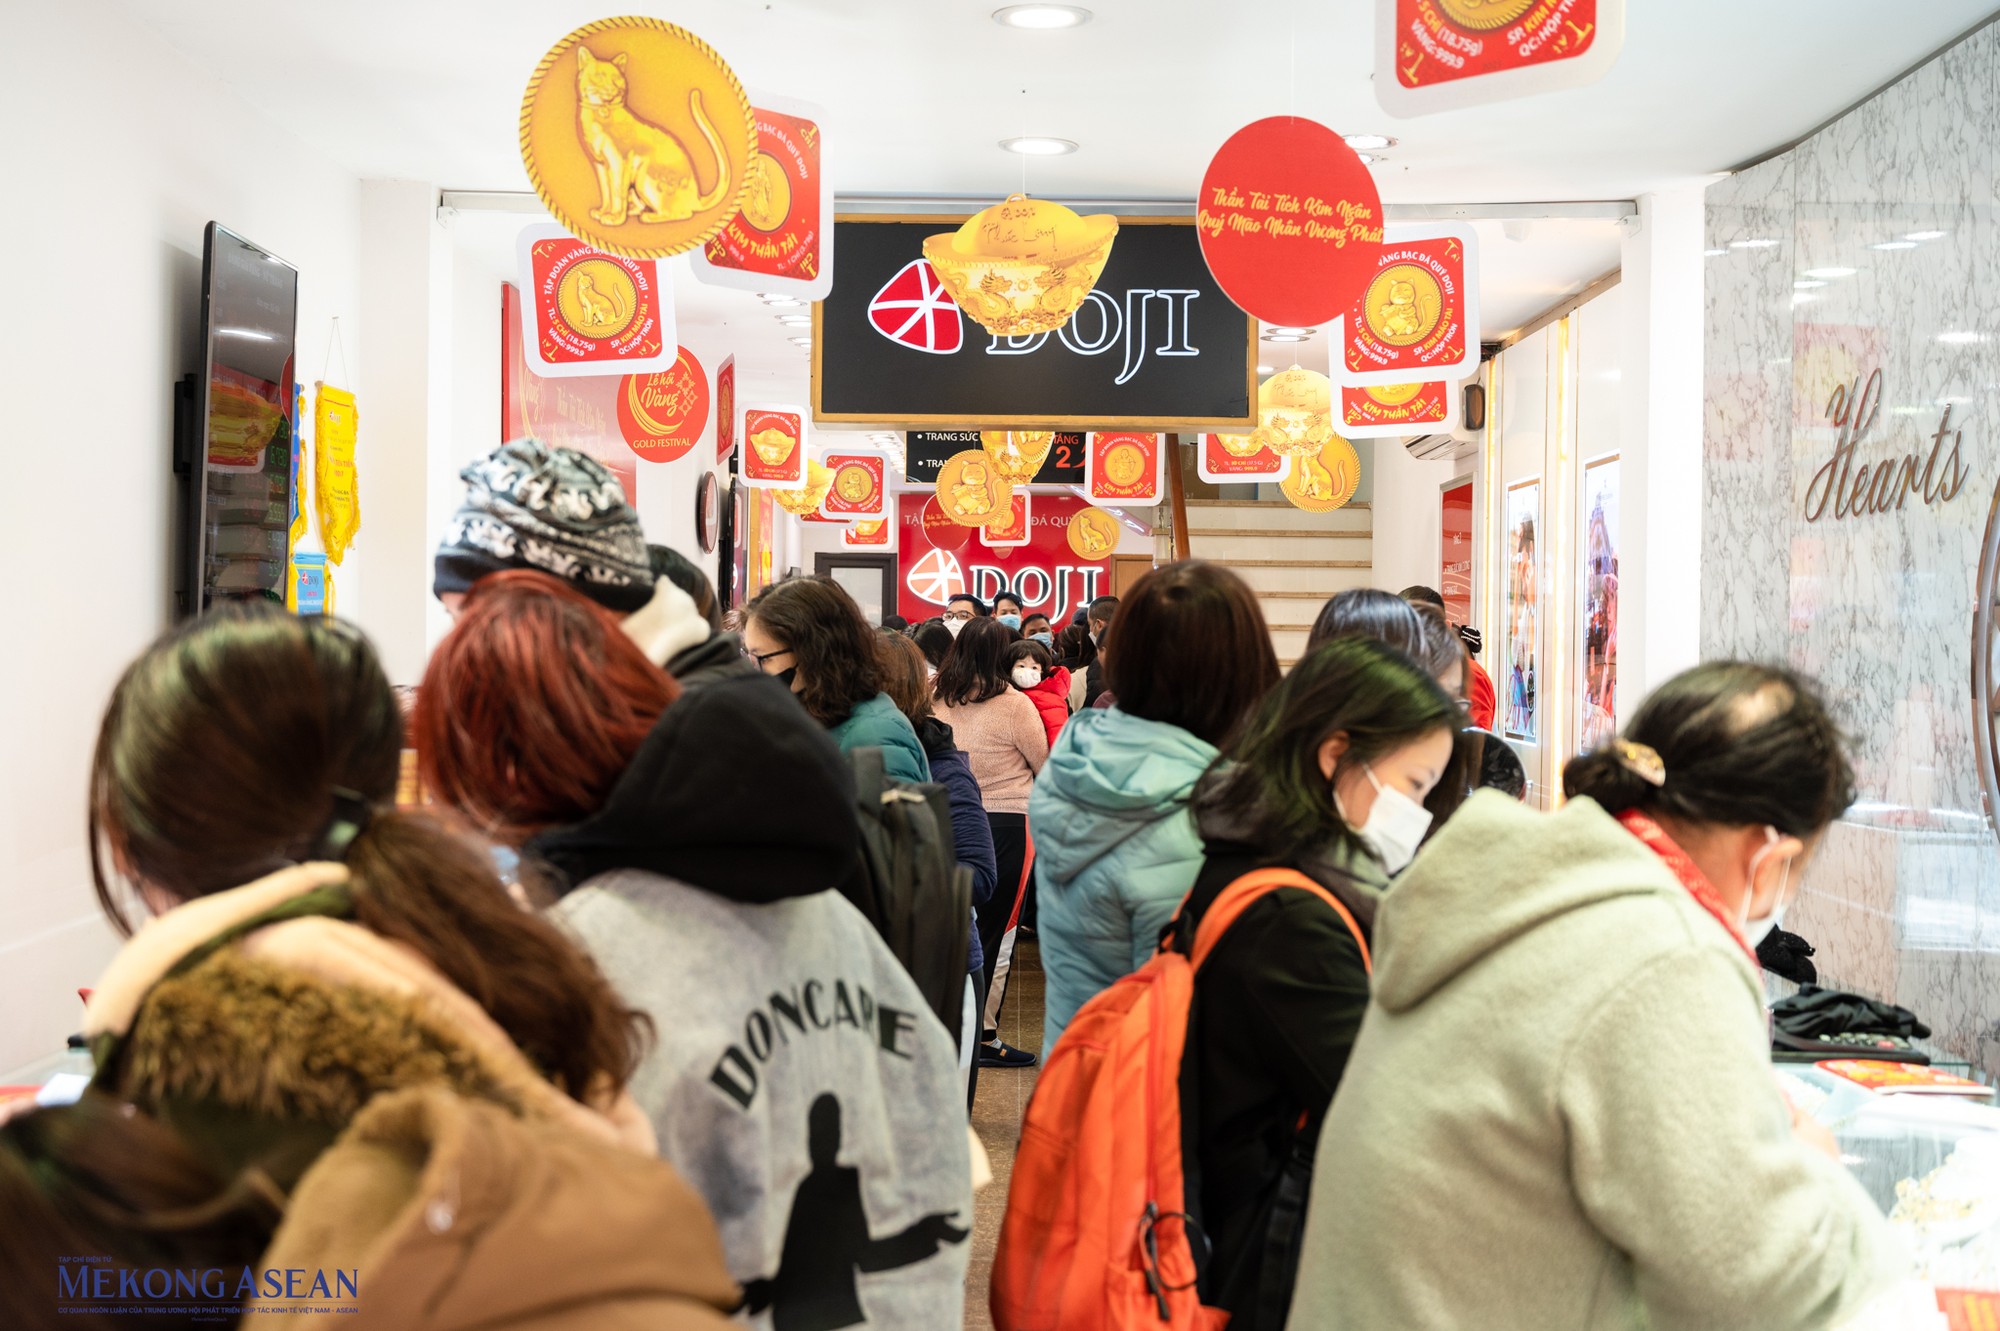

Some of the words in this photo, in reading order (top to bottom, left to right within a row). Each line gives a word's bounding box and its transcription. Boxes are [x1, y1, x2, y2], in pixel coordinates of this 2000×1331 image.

[1524, 4, 1550, 33] KIM
[763, 122, 777, 136] BẠC
[777, 131, 788, 144] ĐÁ
[796, 156, 809, 180] DOJI
[1212, 187, 1245, 208] Thần
[1249, 191, 1271, 211] Tài
[1274, 193, 1300, 213] Tích
[1304, 197, 1333, 217] Kim
[1336, 200, 1372, 226] Ngân
[727, 222, 749, 249] KIM
[750, 235, 780, 259] THẦN
[782, 232, 800, 252] TÀI
[1198, 209, 1225, 237] Quý
[1228, 213, 1262, 236] Mão
[1264, 216, 1302, 239] Nhân
[1305, 220, 1349, 248] Vượng
[1351, 224, 1383, 243] Phát
[544, 278, 553, 295] TẬP
[550, 256, 569, 280] ĐOÀN
[568, 246, 592, 260] VÀNG
[623, 257, 640, 272] QUÝ
[635, 272, 649, 291] DOJI
[1378, 251, 1400, 266] VÀNG
[1401, 251, 1418, 261] BẠC
[1419, 253, 1431, 264] ĐÁ
[1430, 260, 1447, 275] QUÝ
[1442, 275, 1455, 295] DOJI
[548, 307, 557, 320] TL:
[566, 334, 596, 351] (18.75g)
[620, 331, 634, 344] KIM
[640, 303, 649, 316] TÀI
[640, 318, 654, 338] TRÒN
[1423, 338, 1436, 350] KIM
[1444, 307, 1453, 320] TÀI
[1444, 323, 1458, 343] TRÒN
[1371, 342, 1399, 359] (18.75g)
[660, 372, 675, 388] hội
[641, 387, 680, 417] Vàng
[1362, 401, 1381, 416] KIM
[1383, 405, 1409, 419] THẦN
[1410, 398, 1427, 414] TÀI
[633, 439, 656, 448] GOLD
[658, 437, 691, 447] FESTIVAL
[925, 433, 958, 441] TRANG
[960, 431, 979, 441] SỨC
[1805, 368, 1969, 522] Hearts
[926, 459, 947, 468] TRA
[1056, 445, 1070, 468] 2
[904, 513, 923, 527] TẬ
[1031, 514, 1047, 526] ĐÁ
[969, 565, 1104, 625] DOJI
